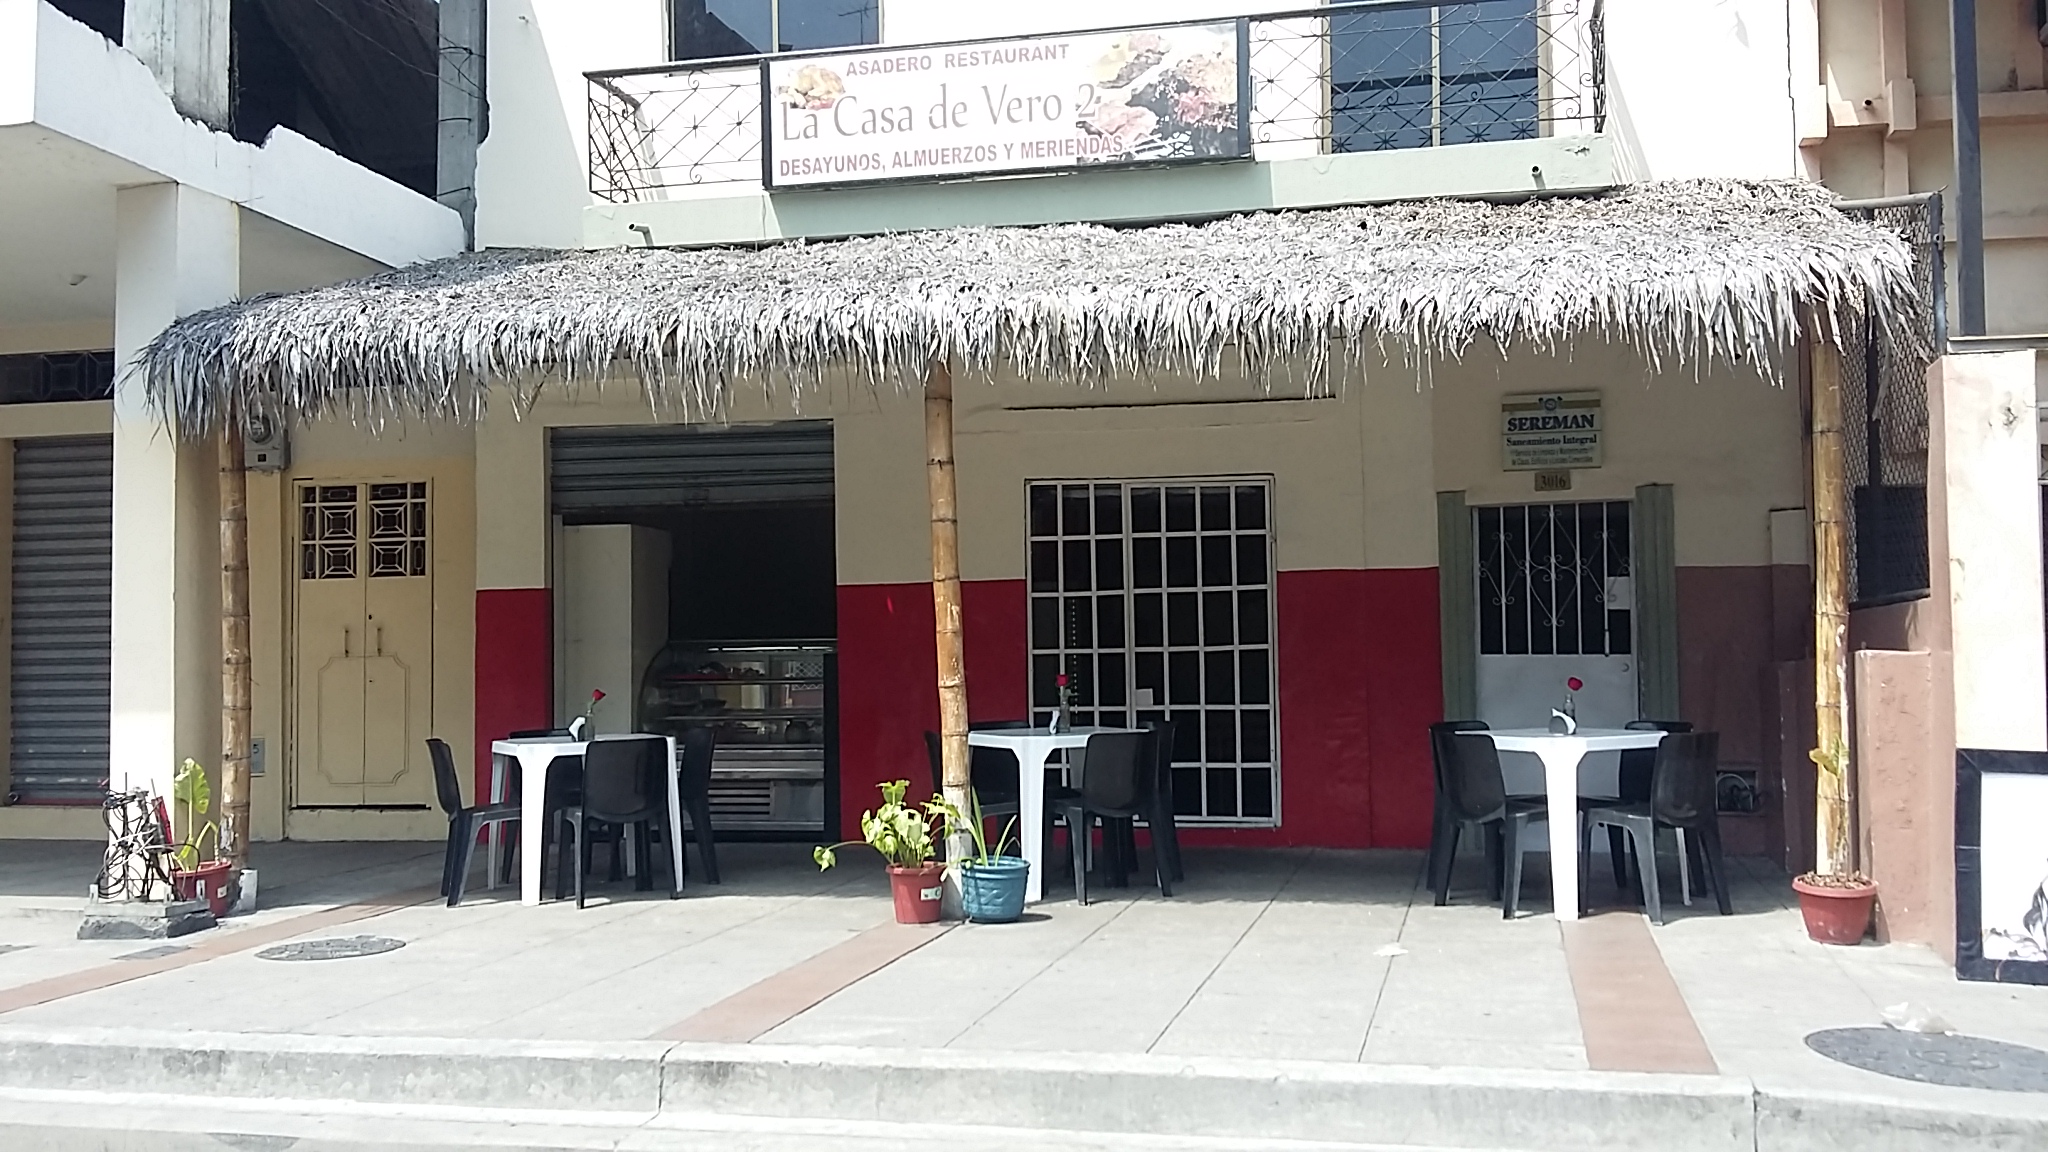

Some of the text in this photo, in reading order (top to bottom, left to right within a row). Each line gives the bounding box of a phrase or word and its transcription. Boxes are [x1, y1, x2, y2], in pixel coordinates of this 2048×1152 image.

[846, 44, 1069, 77] ASADERO RESTAURANT
[780, 83, 1096, 141] La Casa de Vero 2
[780, 135, 1124, 177] DESAYUNOS, ALMUERZOS Y MERIENDAS
[1507, 414, 1595, 432] SEREMAN
[1506, 434, 1597, 447] Saneamiento Integral
[1540, 475, 1566, 489] 3016
